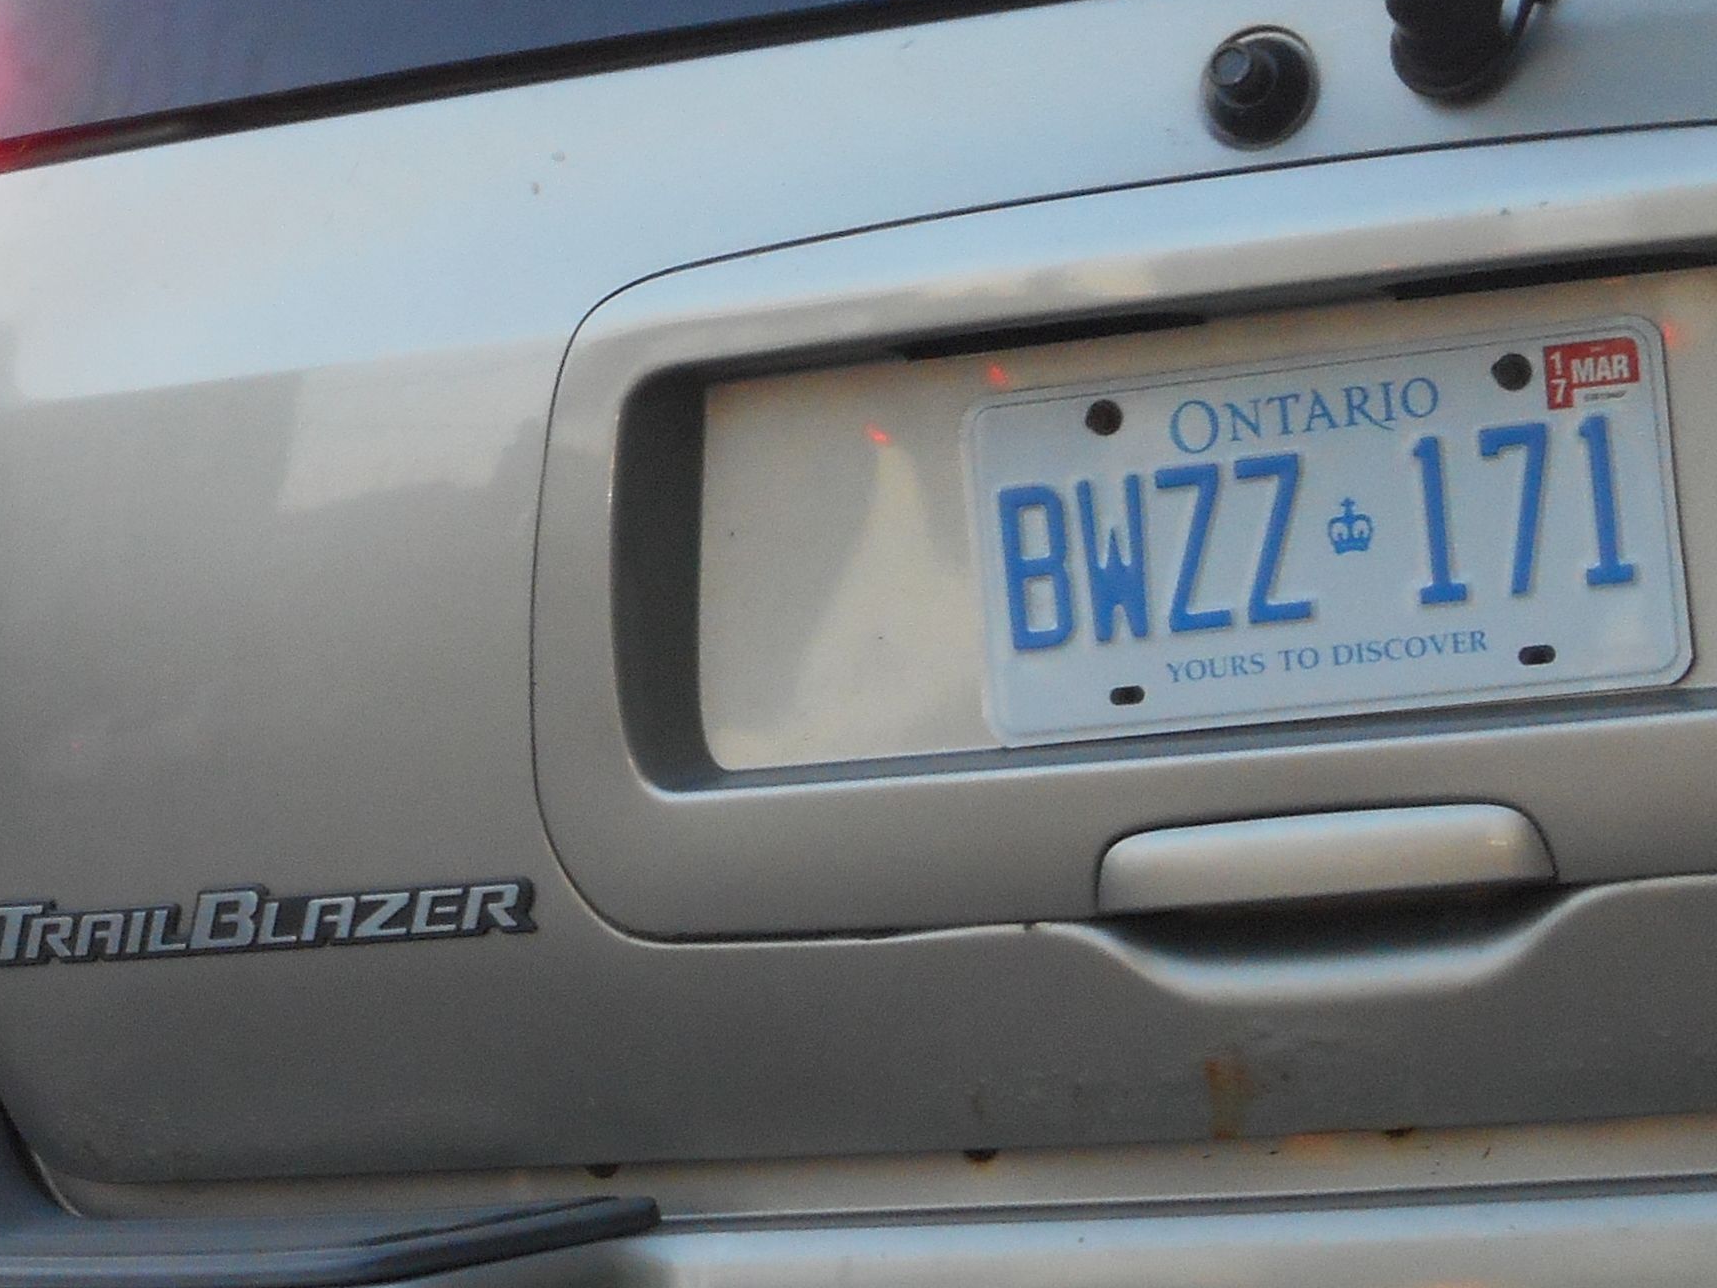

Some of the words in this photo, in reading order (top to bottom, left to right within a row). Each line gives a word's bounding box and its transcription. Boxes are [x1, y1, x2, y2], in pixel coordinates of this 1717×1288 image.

[1570, 354, 1630, 383] MAR
[1170, 376, 1440, 454] ONTARIO
[998, 453, 1312, 652] BWZZ
[1413, 414, 1635, 606] 171
[1166, 651, 1266, 683] YOURS
[1279, 645, 1317, 672] TO
[1332, 629, 1488, 668] DISCOVER
